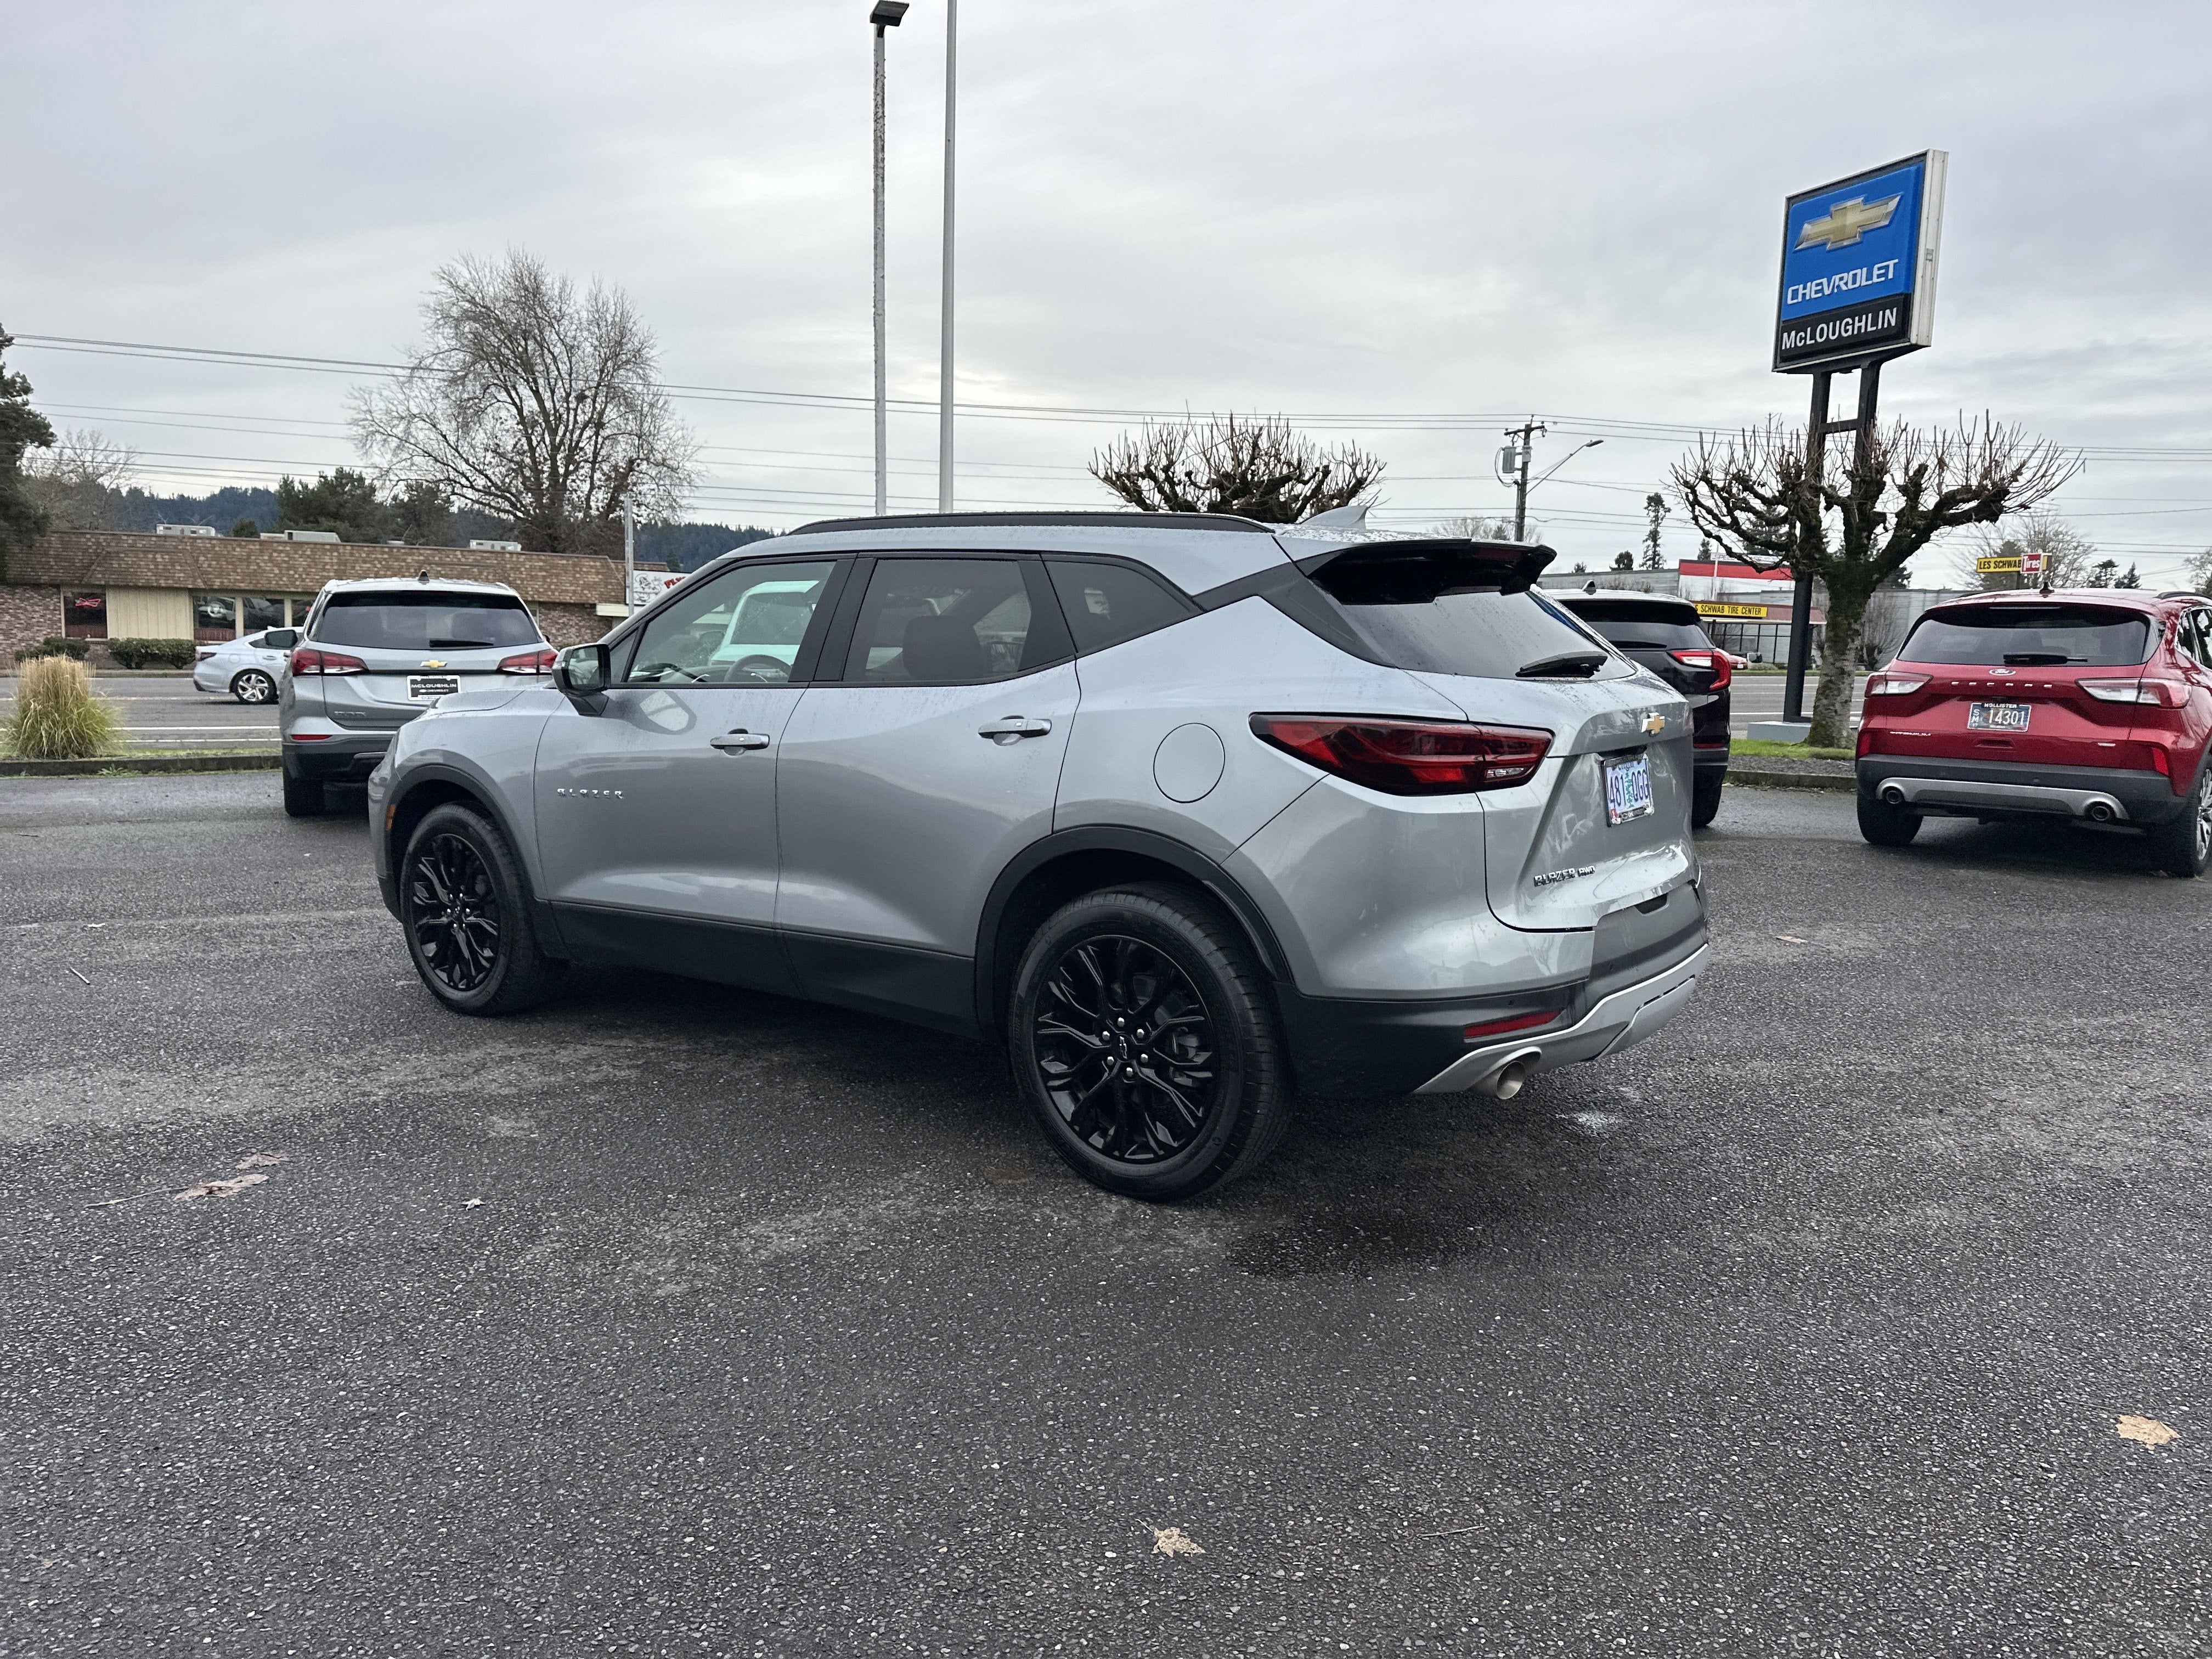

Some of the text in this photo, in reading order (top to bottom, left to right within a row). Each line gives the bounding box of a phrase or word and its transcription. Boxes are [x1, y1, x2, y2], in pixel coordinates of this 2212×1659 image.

[1787, 259, 1899, 304] CHEVROLET
[1782, 307, 1897, 350] McLOUGHLIN
[1979, 560, 2022, 569] LES SCHWAB
[2022, 556, 2040, 571] Tires
[1701, 605, 1725, 613] SCHWAB
[1728, 606, 1739, 614] TIRE
[1741, 607, 1762, 615] CENTER
[1989, 709, 2025, 725] 14301
[557, 788, 624, 799] BLAZER
[1610, 774, 1626, 809] 481
[1534, 865, 1595, 887] BLAZER AWD
